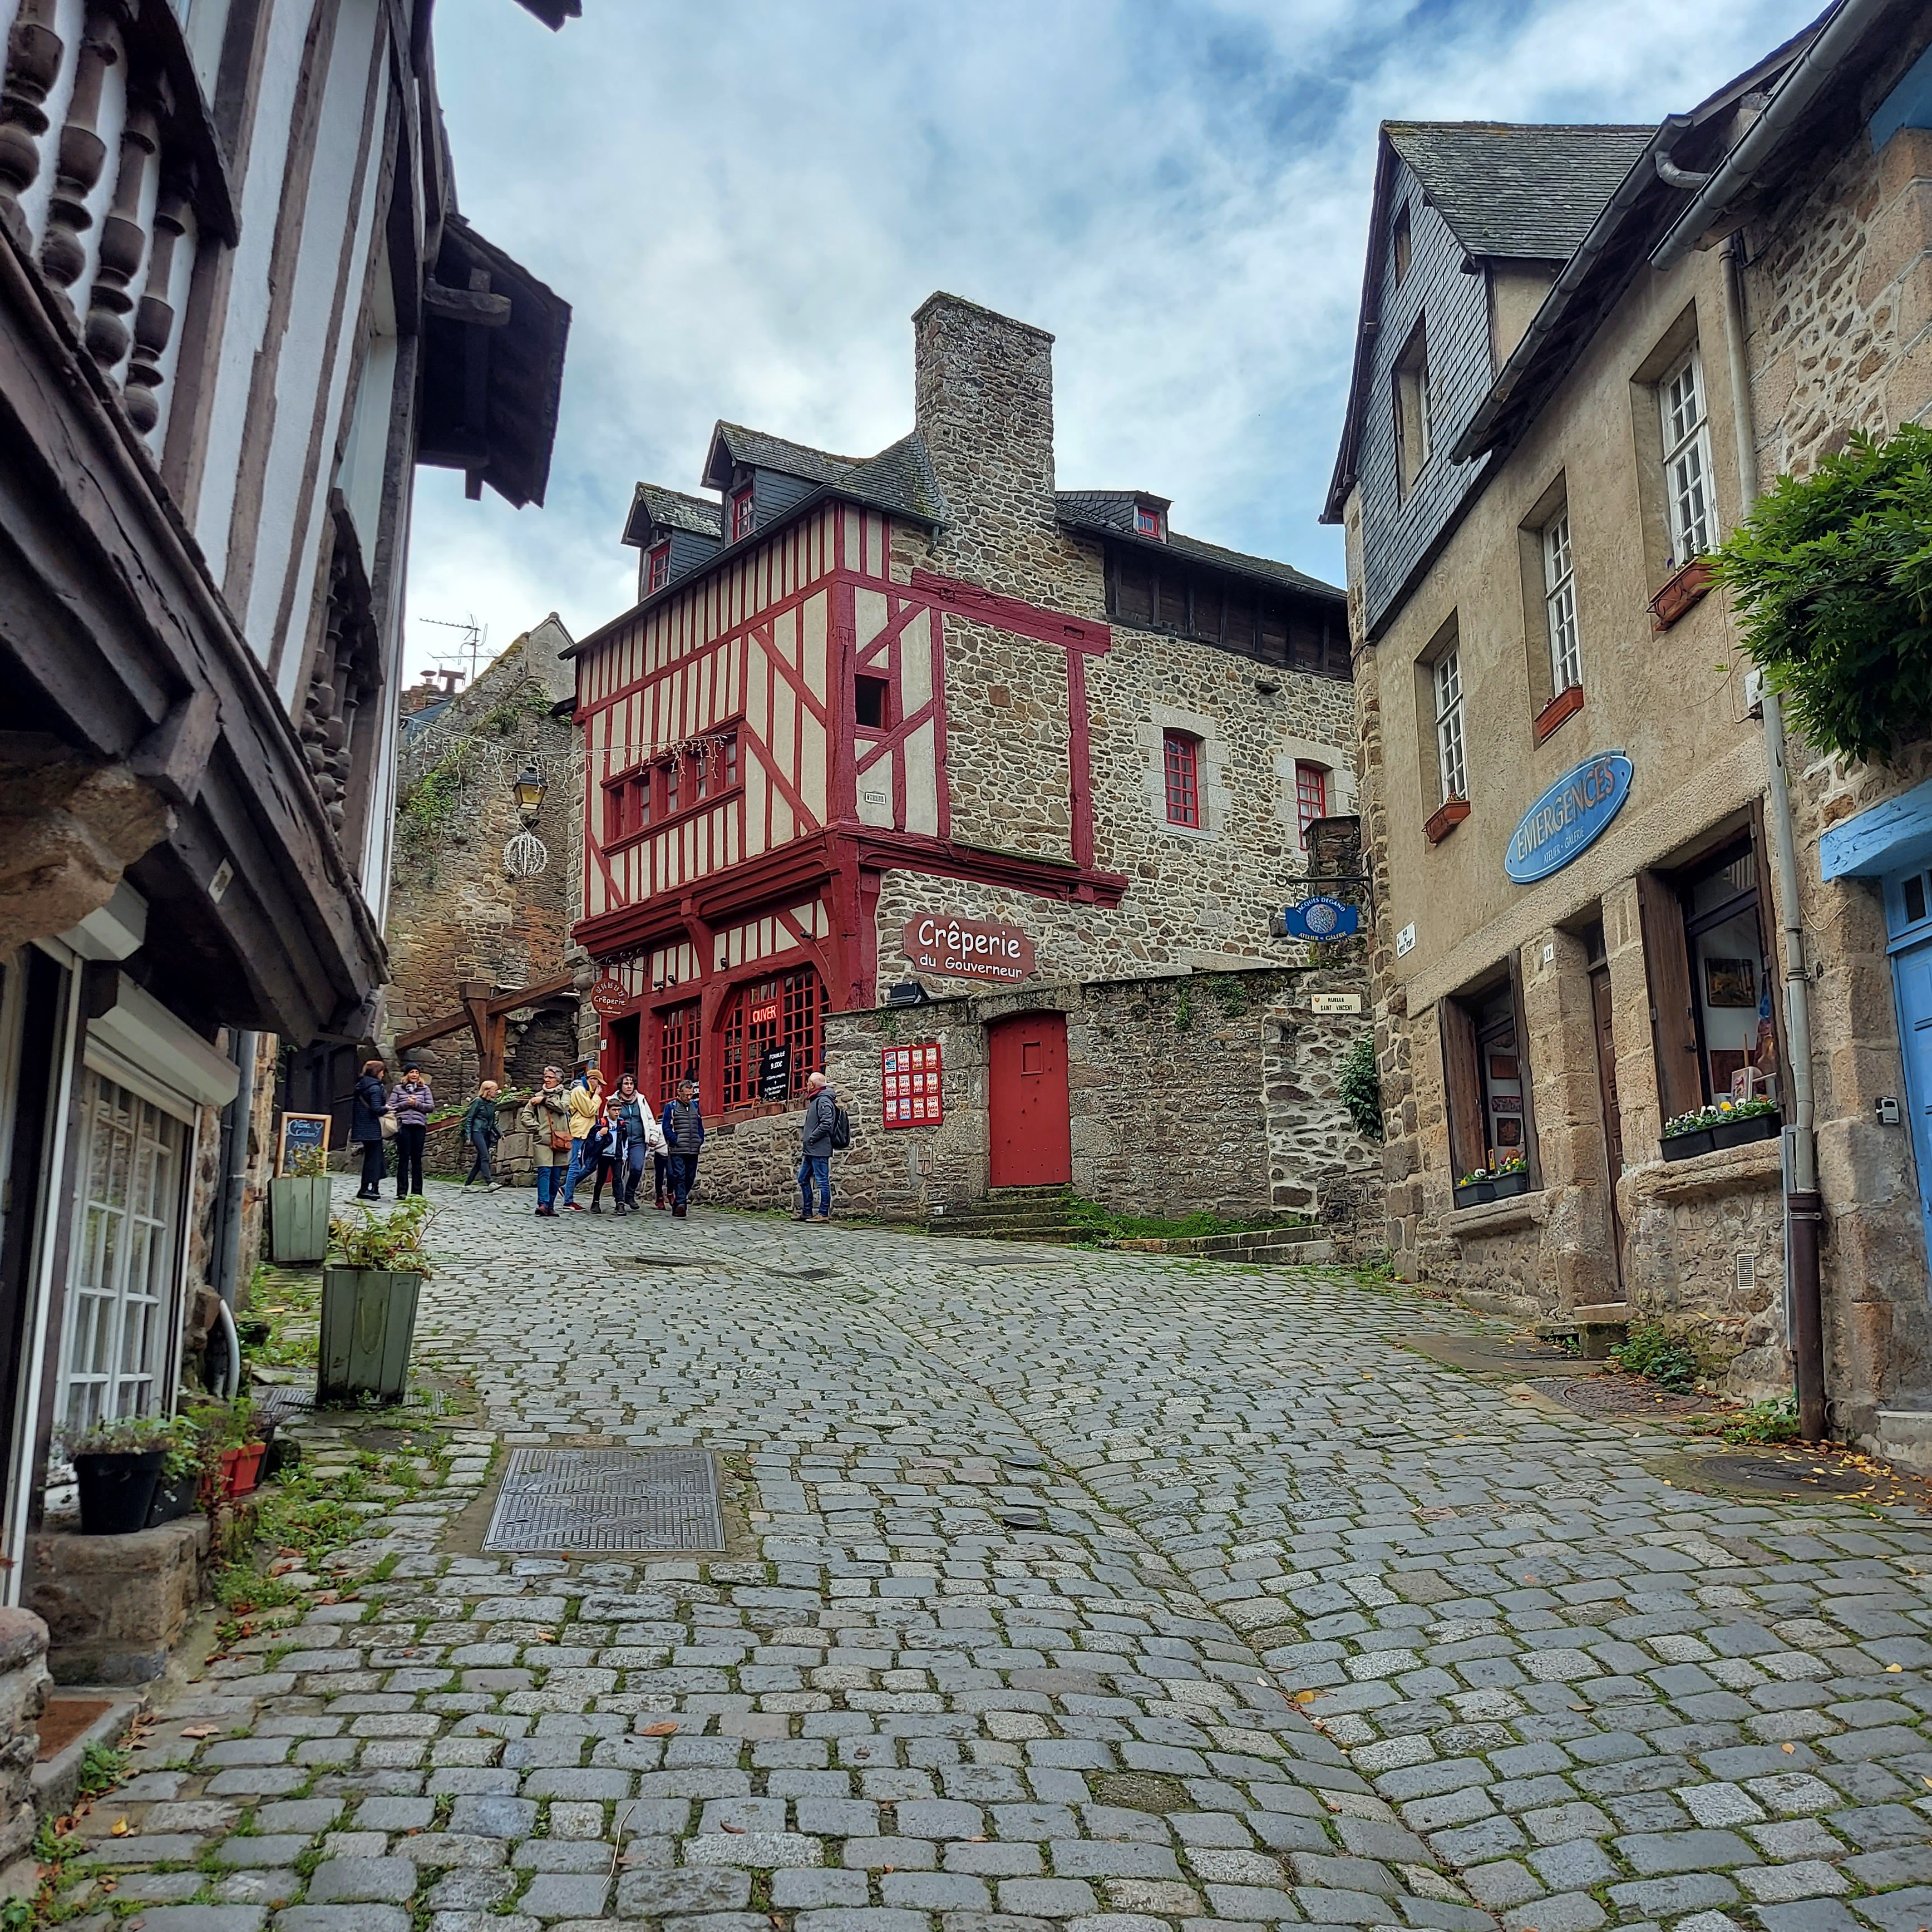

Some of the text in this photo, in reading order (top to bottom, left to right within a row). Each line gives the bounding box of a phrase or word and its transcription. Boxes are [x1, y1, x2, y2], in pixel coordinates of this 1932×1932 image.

[1516, 756, 1615, 862] EMERGENCES
[1544, 826, 1585, 865] ATELIER GALERIE
[1296, 897, 1319, 914] JACQUES
[919, 920, 1021, 960] Crêperie
[1298, 931, 1347, 941] ATELIER GALERIE
[1546, 948, 1551, 959] 17
[919, 953, 1023, 979] du Gouverneur
[594, 995, 627, 1006] Crêperie
[752, 1004, 778, 1023] OUVER
